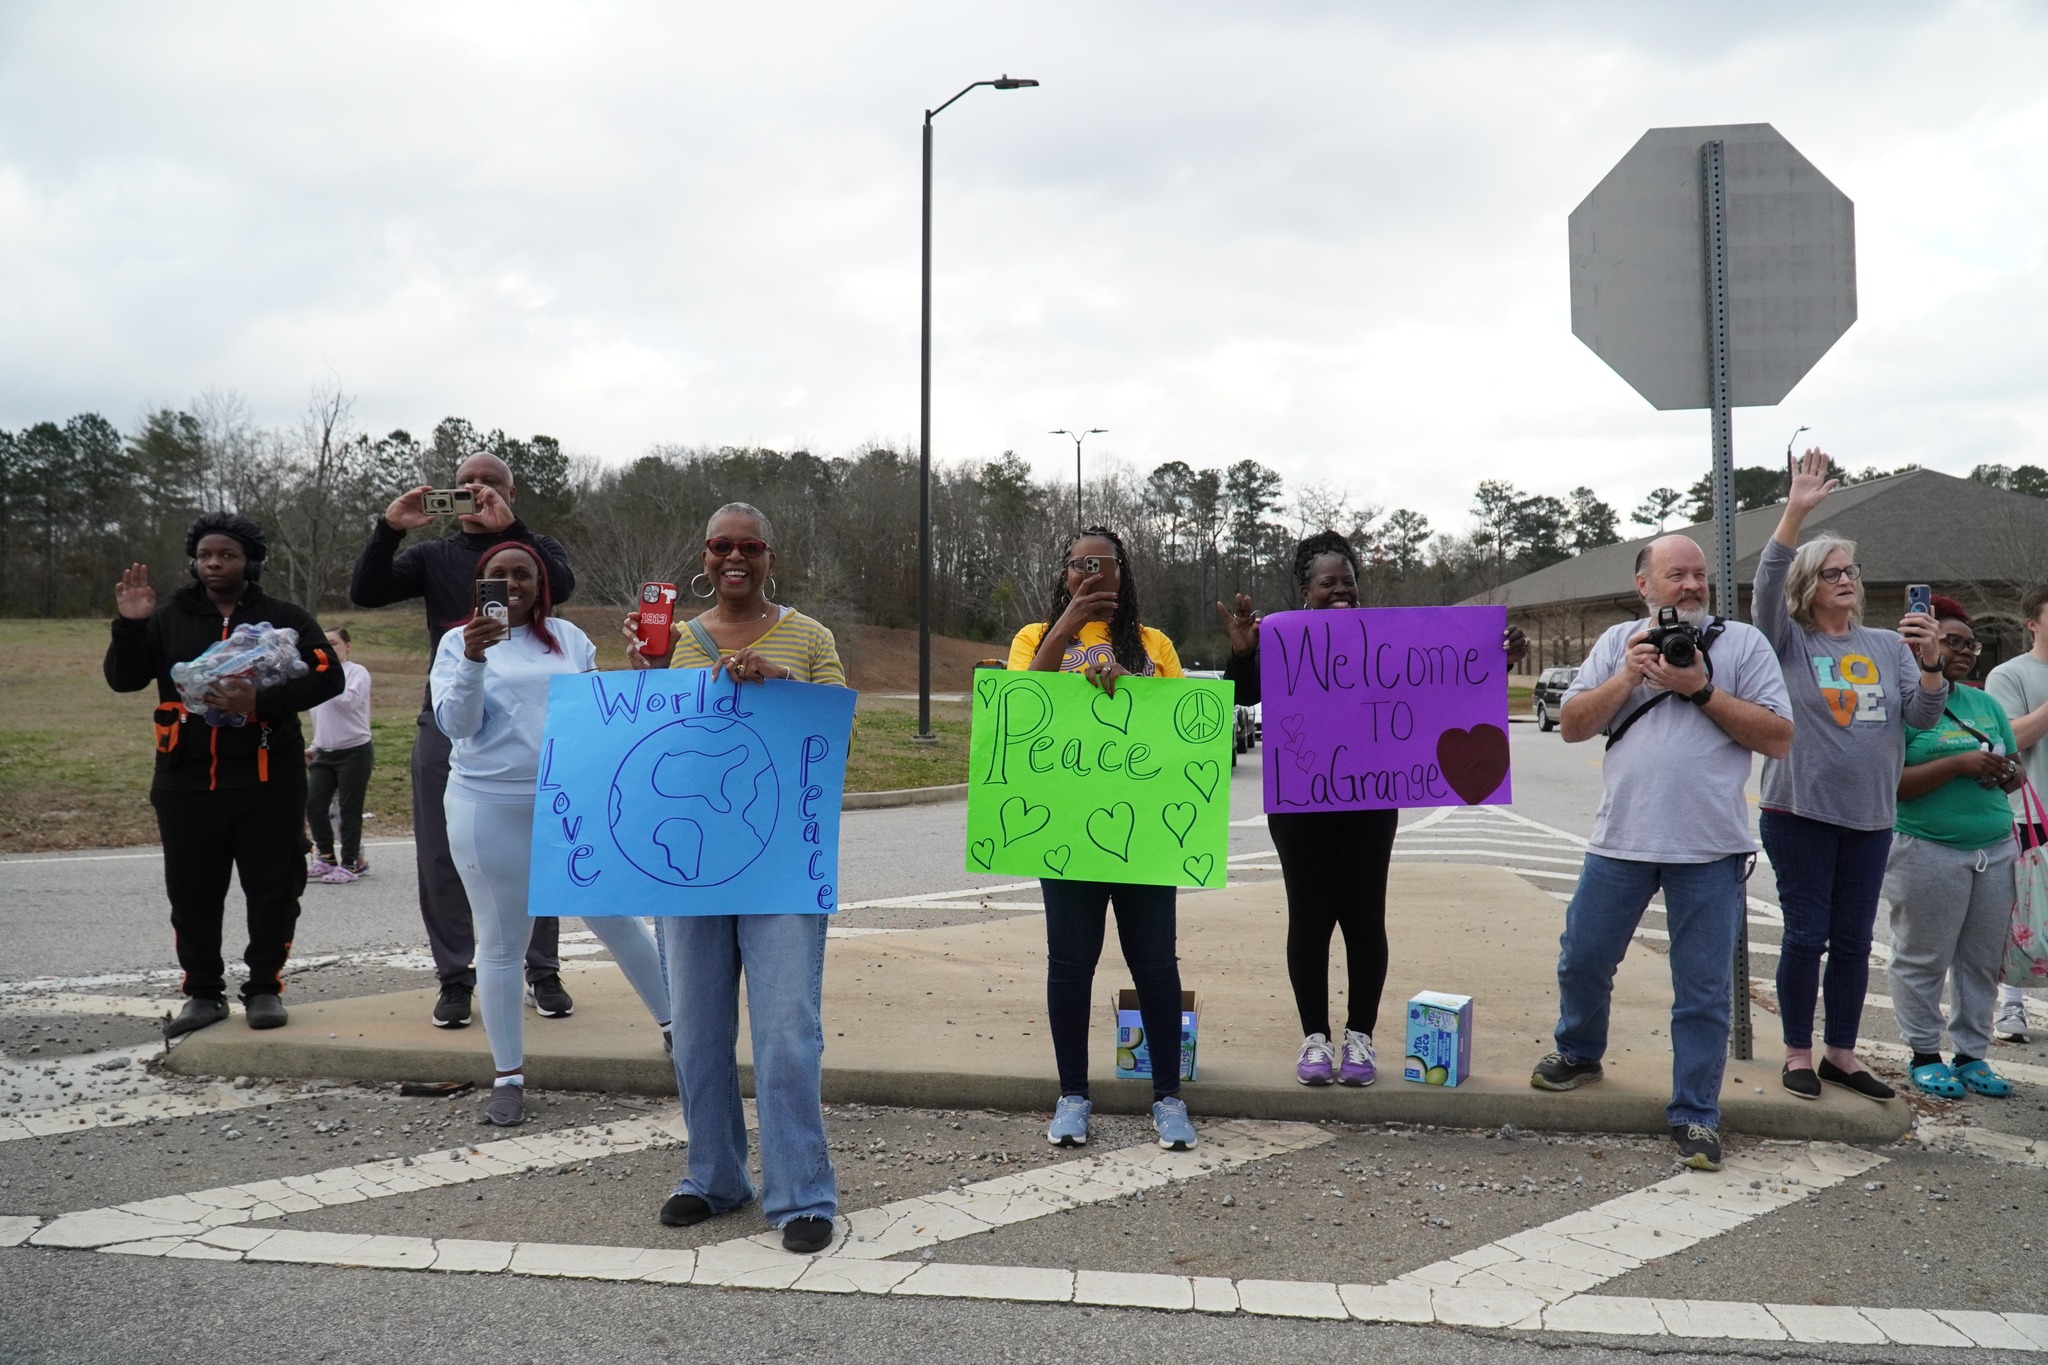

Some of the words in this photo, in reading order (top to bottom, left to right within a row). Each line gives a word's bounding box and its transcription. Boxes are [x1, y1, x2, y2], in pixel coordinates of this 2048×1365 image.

[640, 612, 667, 625] 1913
[1273, 618, 1489, 696] Welcome
[592, 670, 753, 725] World
[982, 678, 1162, 785] Peace
[1274, 744, 1447, 806] LaGrange
[539, 738, 601, 887] Love
[798, 734, 833, 909] Peace
[1122, 1028, 1128, 1038] 12
[1413, 1035, 1422, 1054] VITA
[1406, 1069, 1416, 1077] 12
